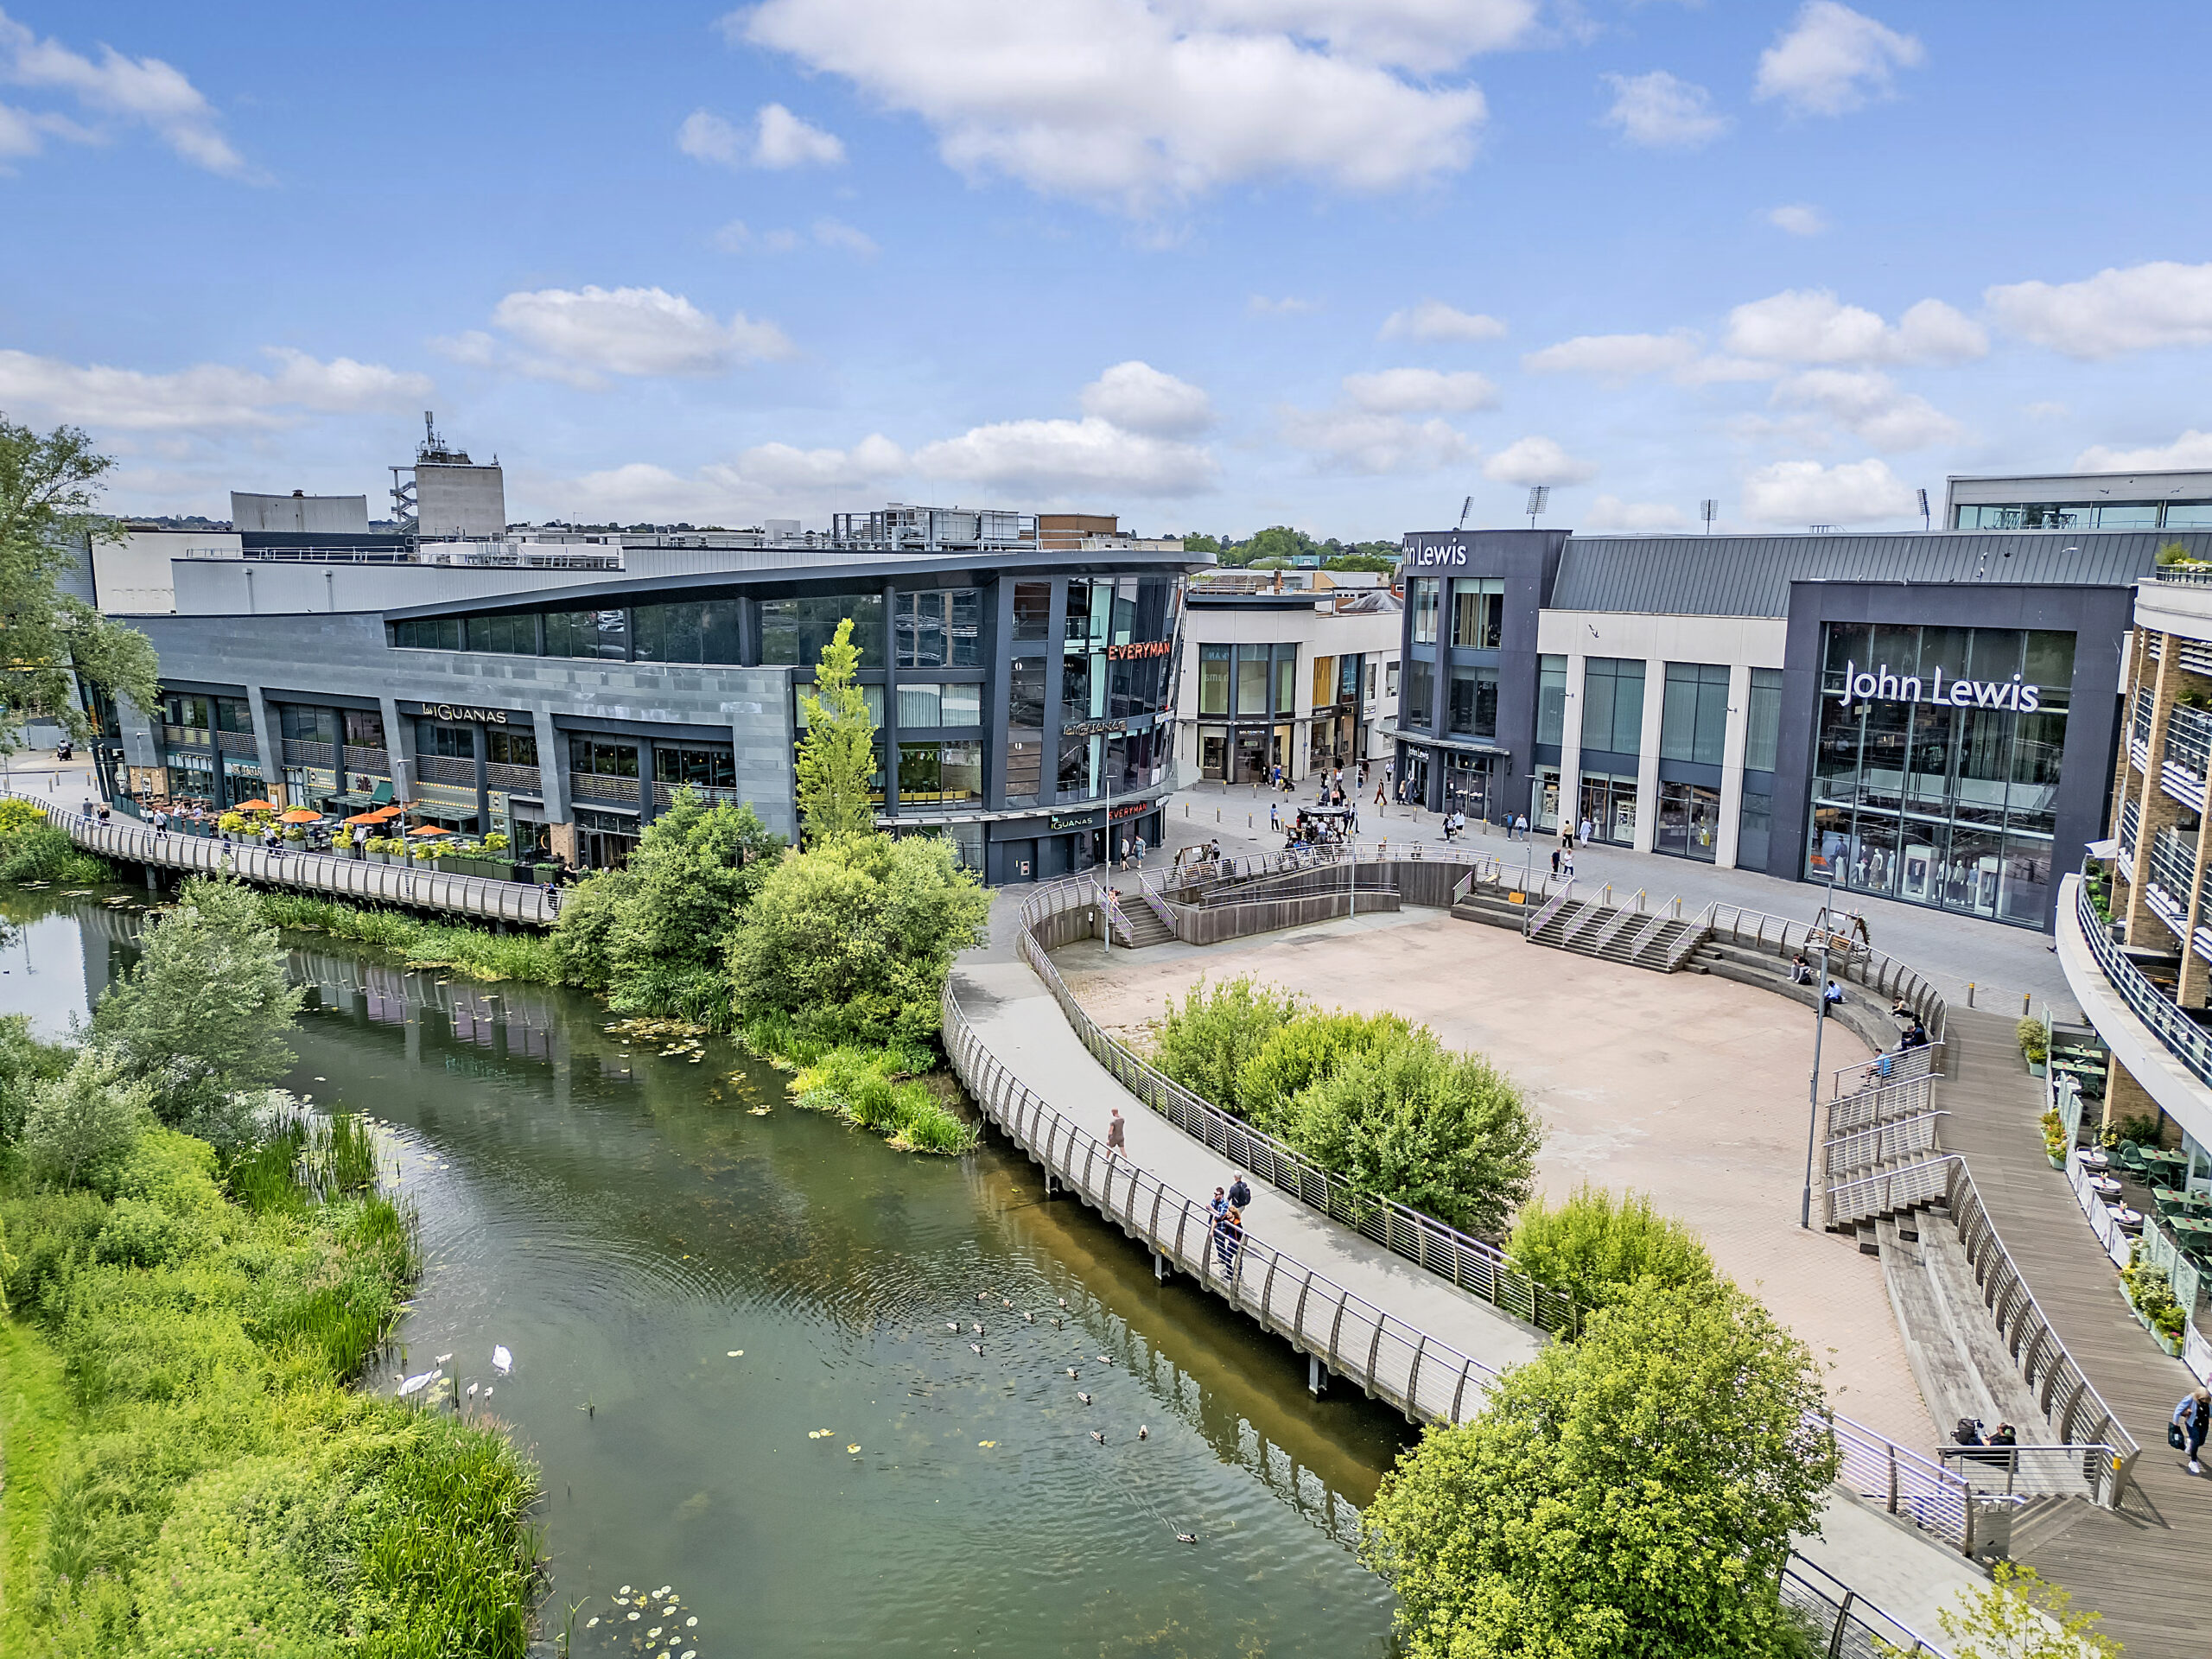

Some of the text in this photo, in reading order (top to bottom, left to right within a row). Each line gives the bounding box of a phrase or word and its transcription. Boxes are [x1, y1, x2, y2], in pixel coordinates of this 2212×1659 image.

[1418, 537, 1467, 566] Lewis
[1108, 642, 1171, 661] EVERYMAN
[1838, 659, 2039, 712] John Lewis
[434, 704, 507, 724] IGUANAS
[1408, 745, 1429, 760] John Lewis
[1108, 803, 1147, 820] EVERYMAN
[1051, 817, 1093, 830] IGUANAS
